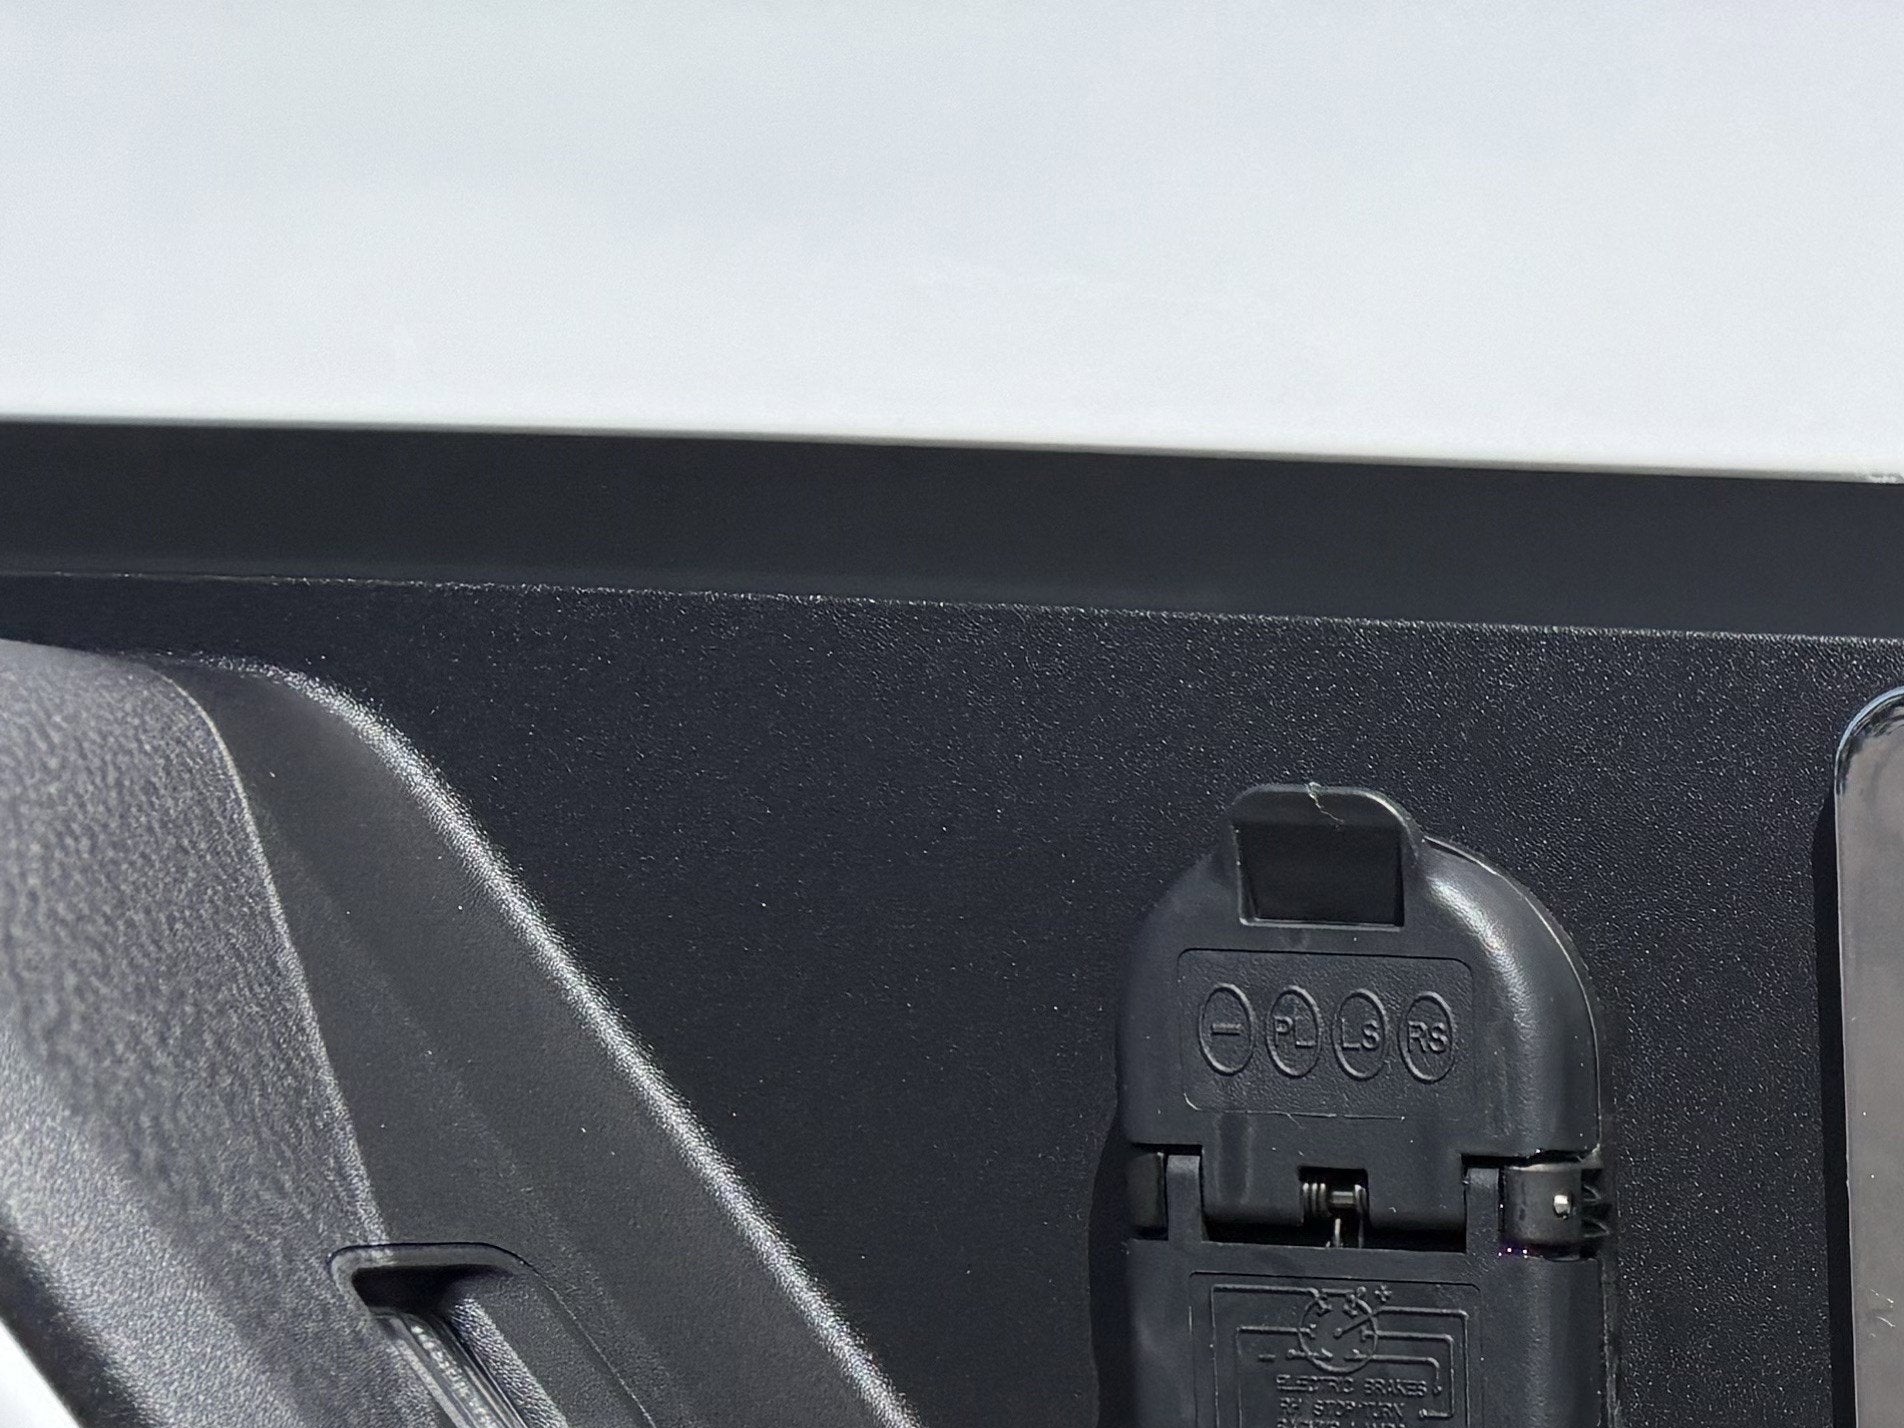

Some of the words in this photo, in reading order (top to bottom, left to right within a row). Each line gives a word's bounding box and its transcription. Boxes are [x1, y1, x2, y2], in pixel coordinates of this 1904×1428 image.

[1272, 1014, 1317, 1049] PL
[1341, 1017, 1380, 1051] LS
[1407, 1020, 1449, 1055] RS
[1364, 1378, 1428, 1397] BRAKES
